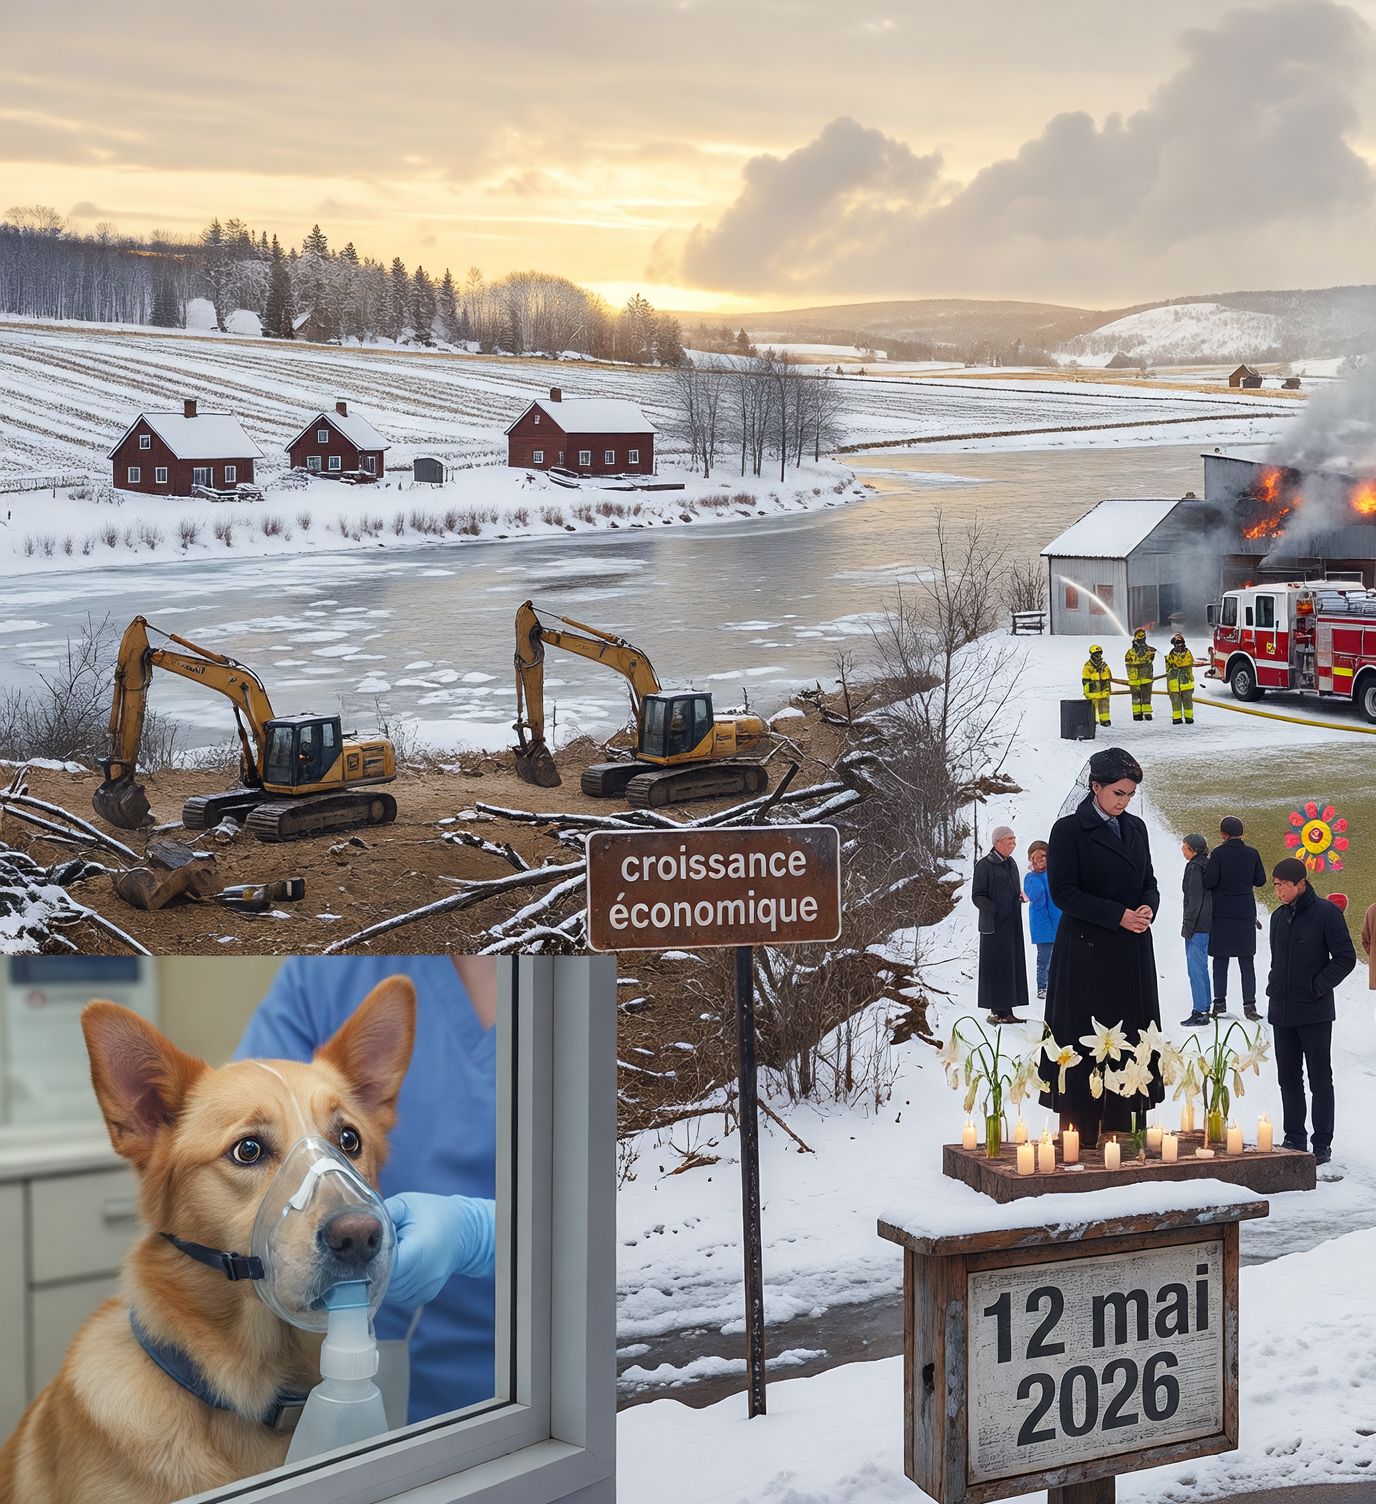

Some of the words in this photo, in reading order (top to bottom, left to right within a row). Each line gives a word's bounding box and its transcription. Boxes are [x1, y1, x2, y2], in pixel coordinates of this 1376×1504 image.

[621, 845, 807, 882] croissance
[609, 890, 819, 932] économique
[983, 1285, 1066, 1364] 12
[1092, 1263, 1209, 1349] mai
[1016, 1351, 1180, 1447] 2026
